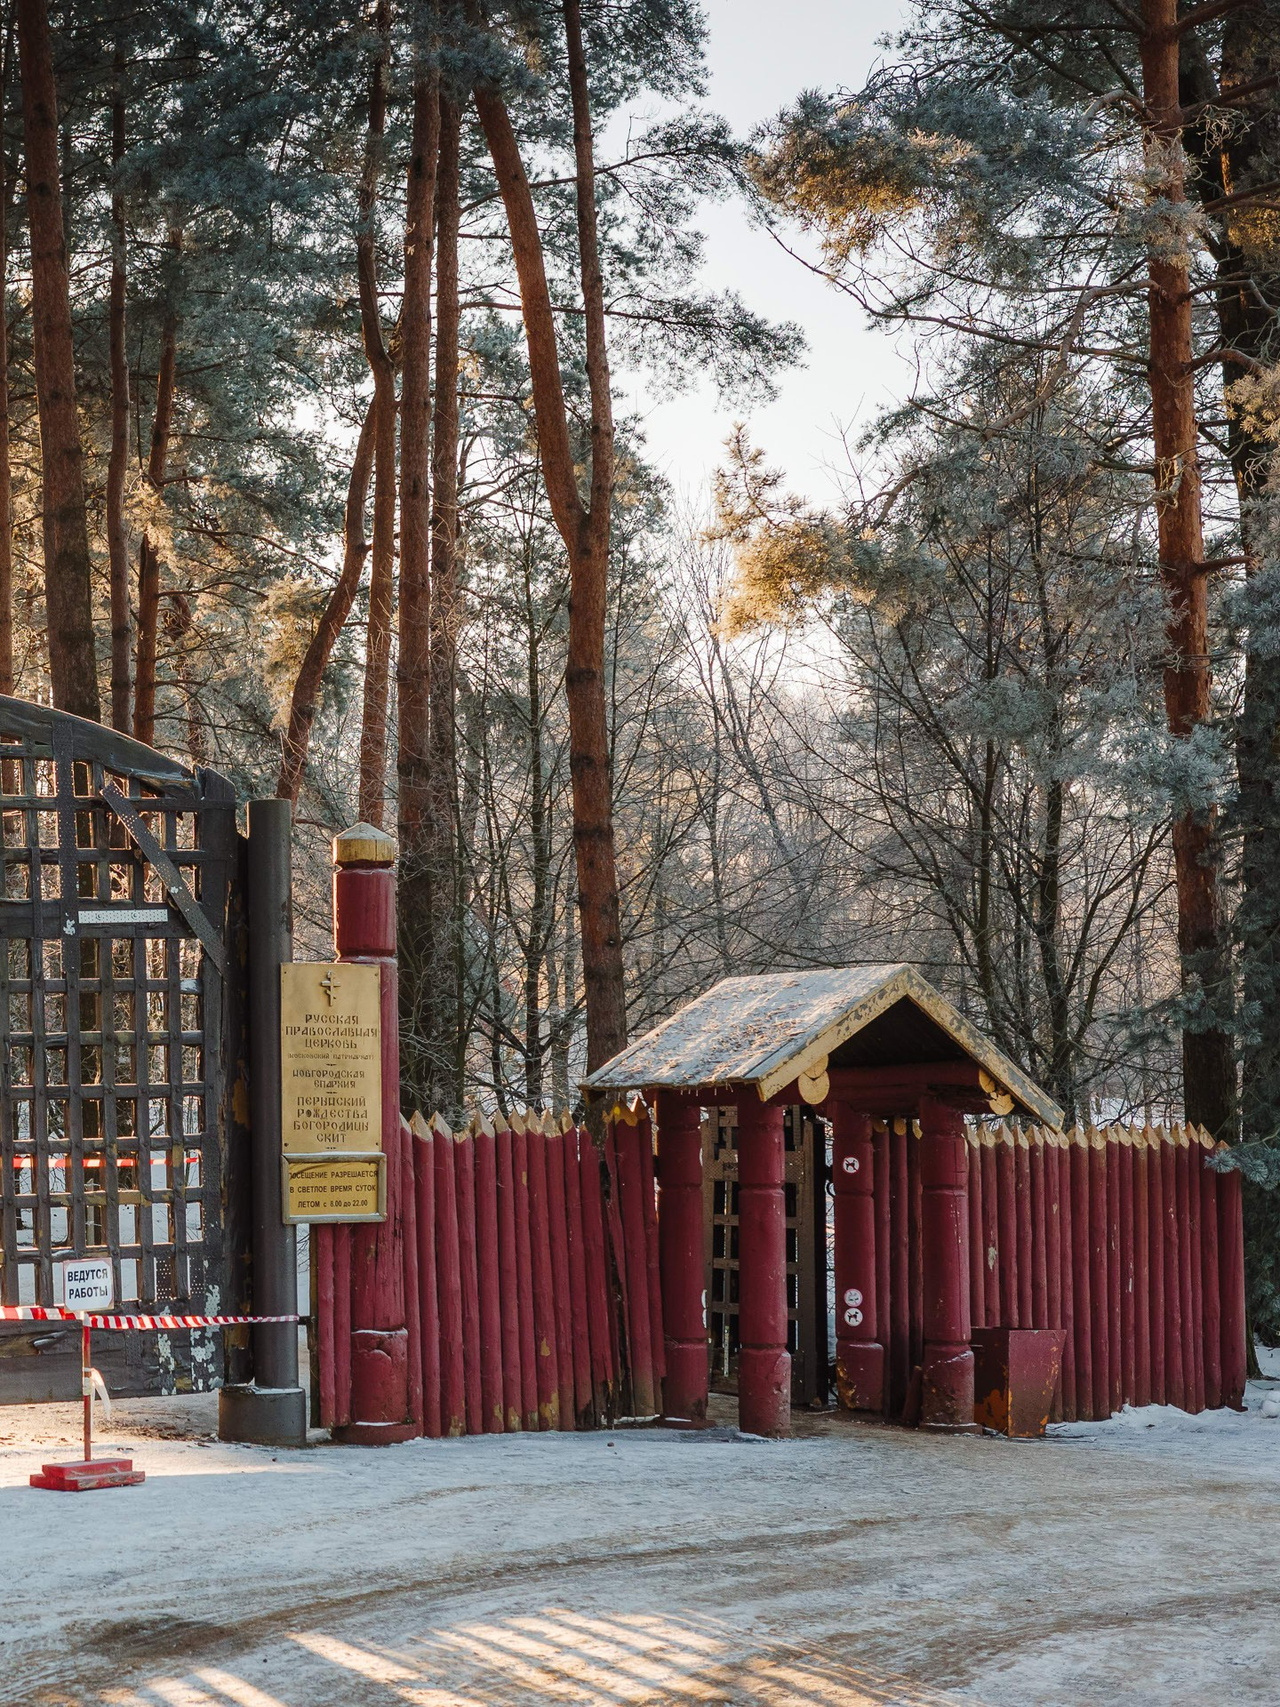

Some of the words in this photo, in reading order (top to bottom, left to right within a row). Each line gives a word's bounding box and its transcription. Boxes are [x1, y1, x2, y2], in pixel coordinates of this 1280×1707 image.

[305, 1014, 359, 1025] РУССКАЯ
[286, 1026, 378, 1037] ПРАВОСЛАВНАЯ
[305, 1038, 357, 1049] ЦЕРКОВЬ
[293, 1069, 365, 1079] НОВГОРОДСКАЯ
[314, 1080, 356, 1089] ЕПАРХИЯ
[297, 1096, 366, 1107] ПЕРЫНСКИЙ
[297, 1109, 368, 1120] РОЖДЕСТВА
[293, 1120, 369, 1133] БОГОРОДИЦЫ
[316, 1133, 347, 1143] СКИТ
[331, 1170, 378, 1178] РАЗРЕШАЕТСЯ
[331, 1185, 353, 1193] ВРЕМЯ
[356, 1184, 376, 1192] СУТОК
[353, 1199, 368, 1207] 22.00
[67, 1268, 108, 1283] ВЕДУТСЯ
[69, 1286, 108, 1299] РАБОТЫ
